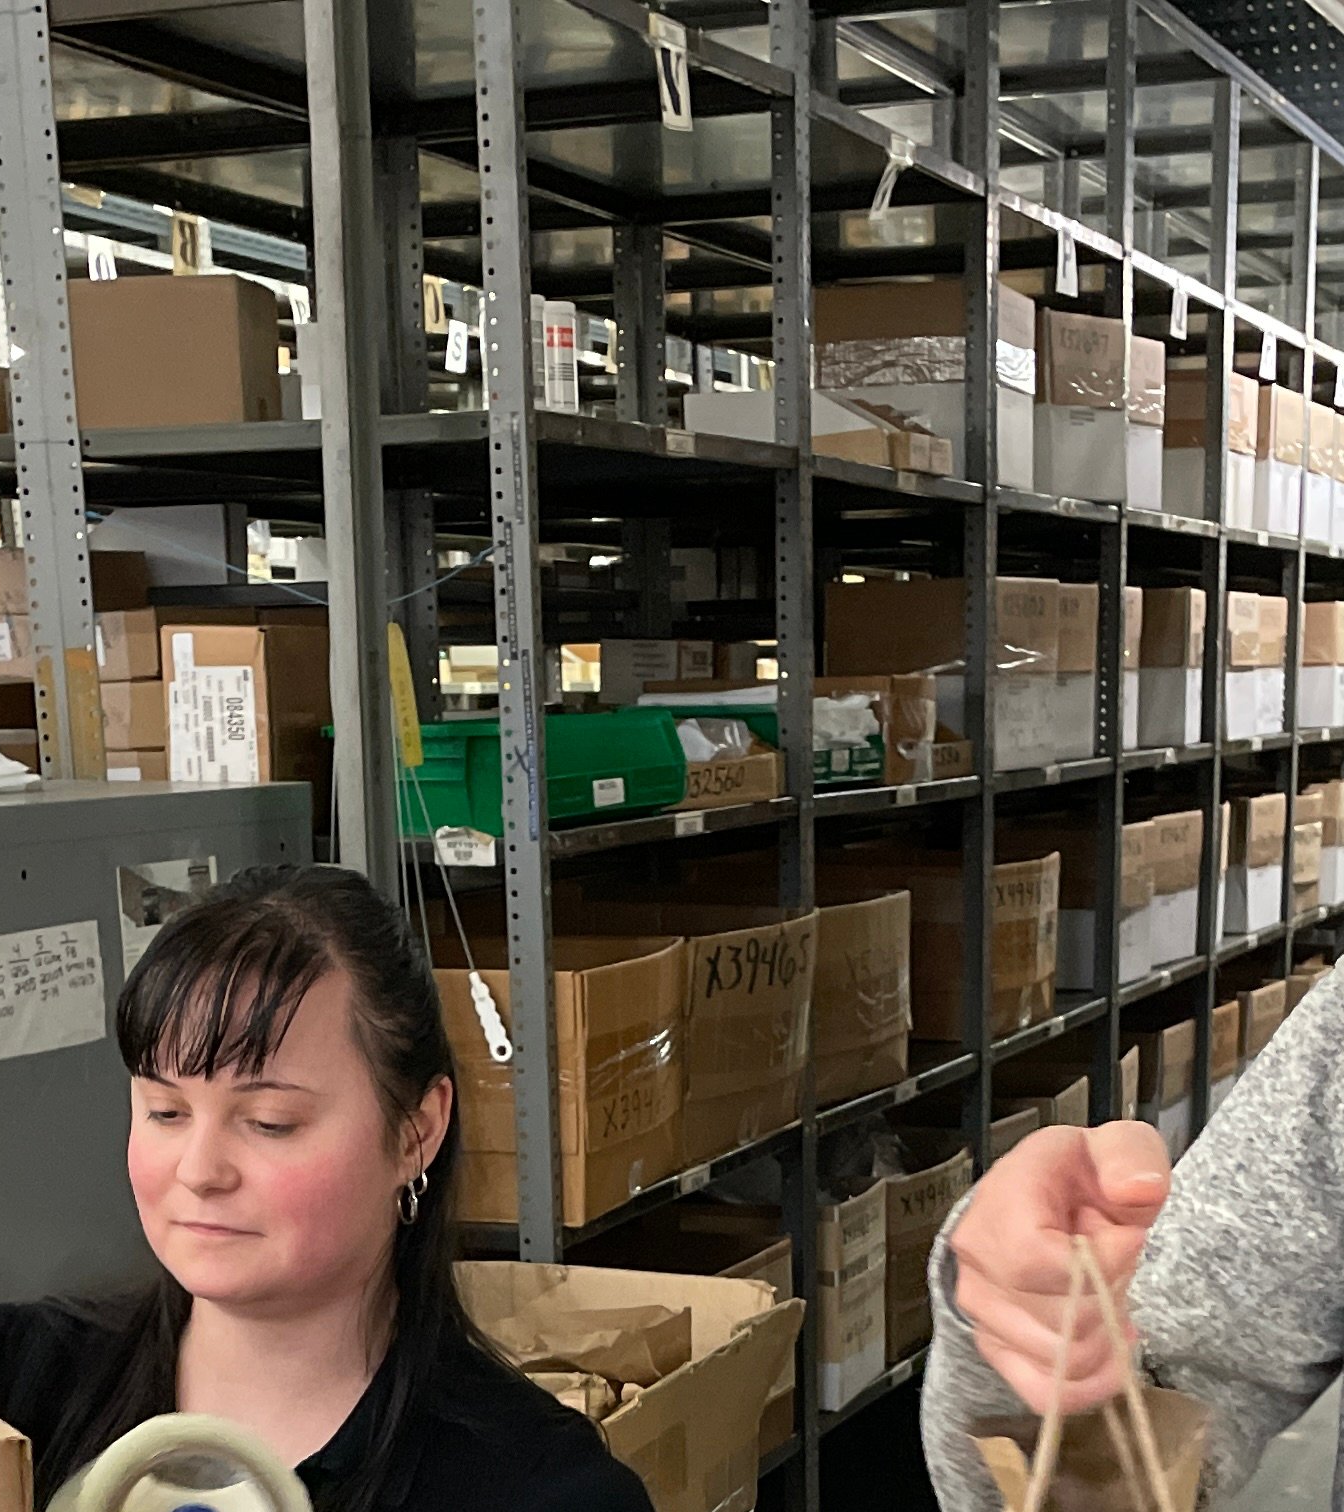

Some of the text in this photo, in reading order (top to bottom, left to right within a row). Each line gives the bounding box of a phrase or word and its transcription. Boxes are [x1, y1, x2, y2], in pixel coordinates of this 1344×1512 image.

[451, 331, 462, 362] S
[687, 766, 745, 798] 32560
[706, 933, 811, 999] X39465
